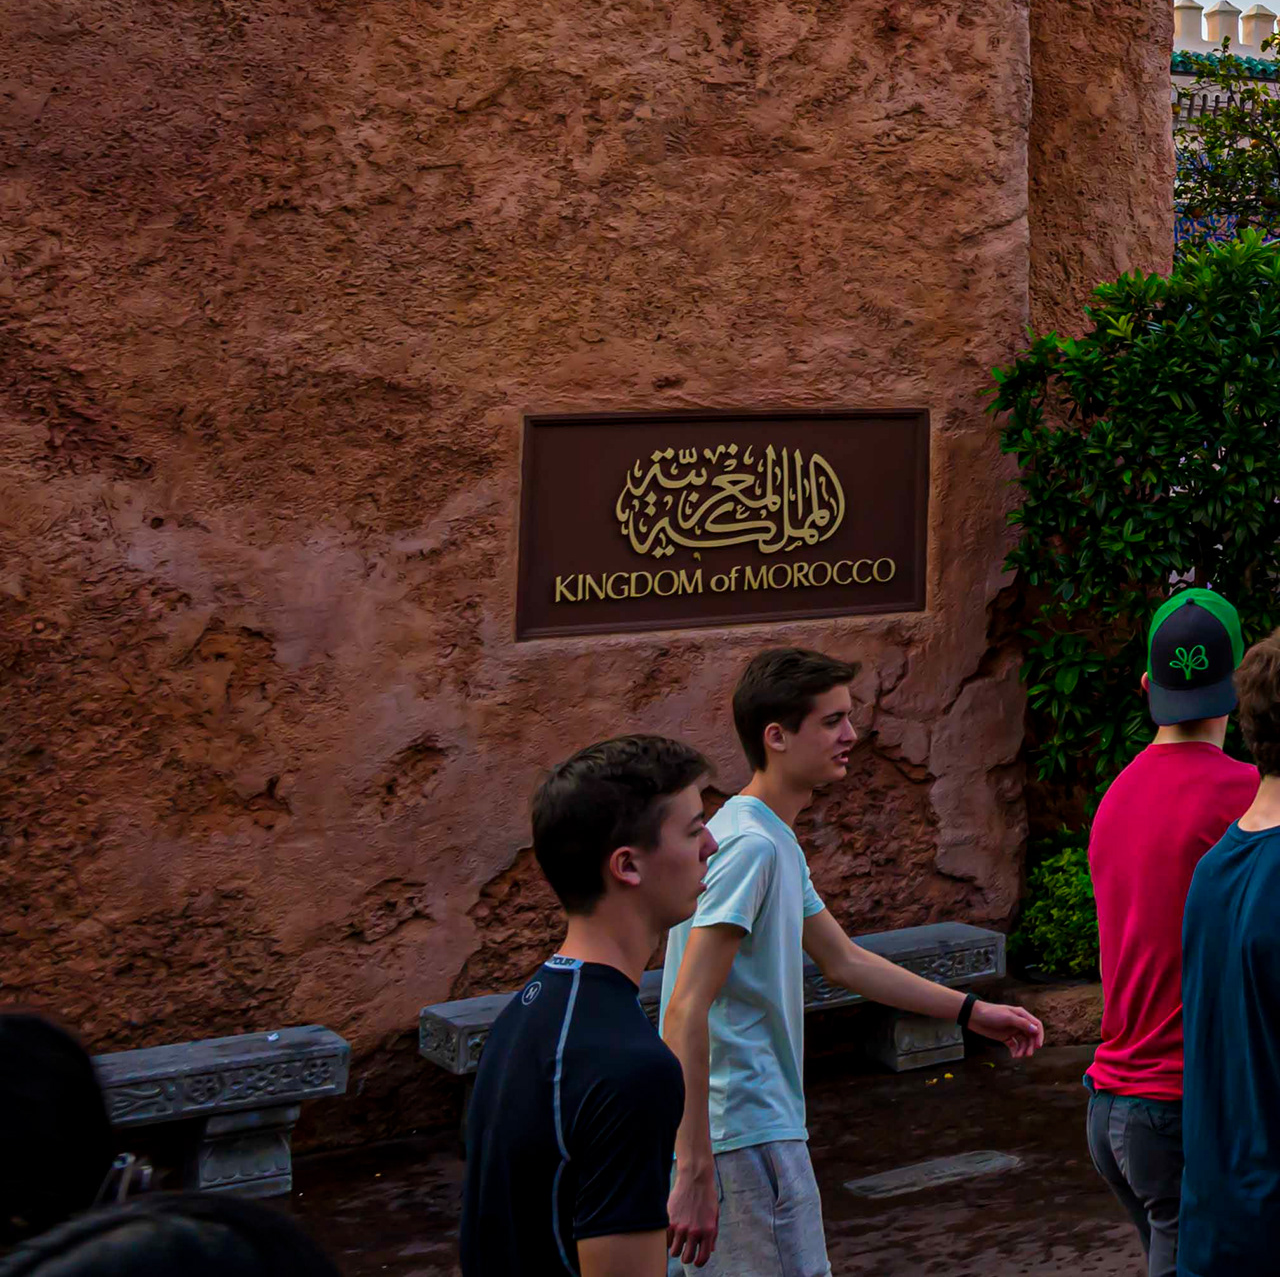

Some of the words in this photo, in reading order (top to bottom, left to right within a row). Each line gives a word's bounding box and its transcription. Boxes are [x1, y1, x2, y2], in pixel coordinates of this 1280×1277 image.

[554, 569, 703, 603] KINGDOM
[710, 567, 740, 592] of
[744, 557, 897, 591] MOROCCO
